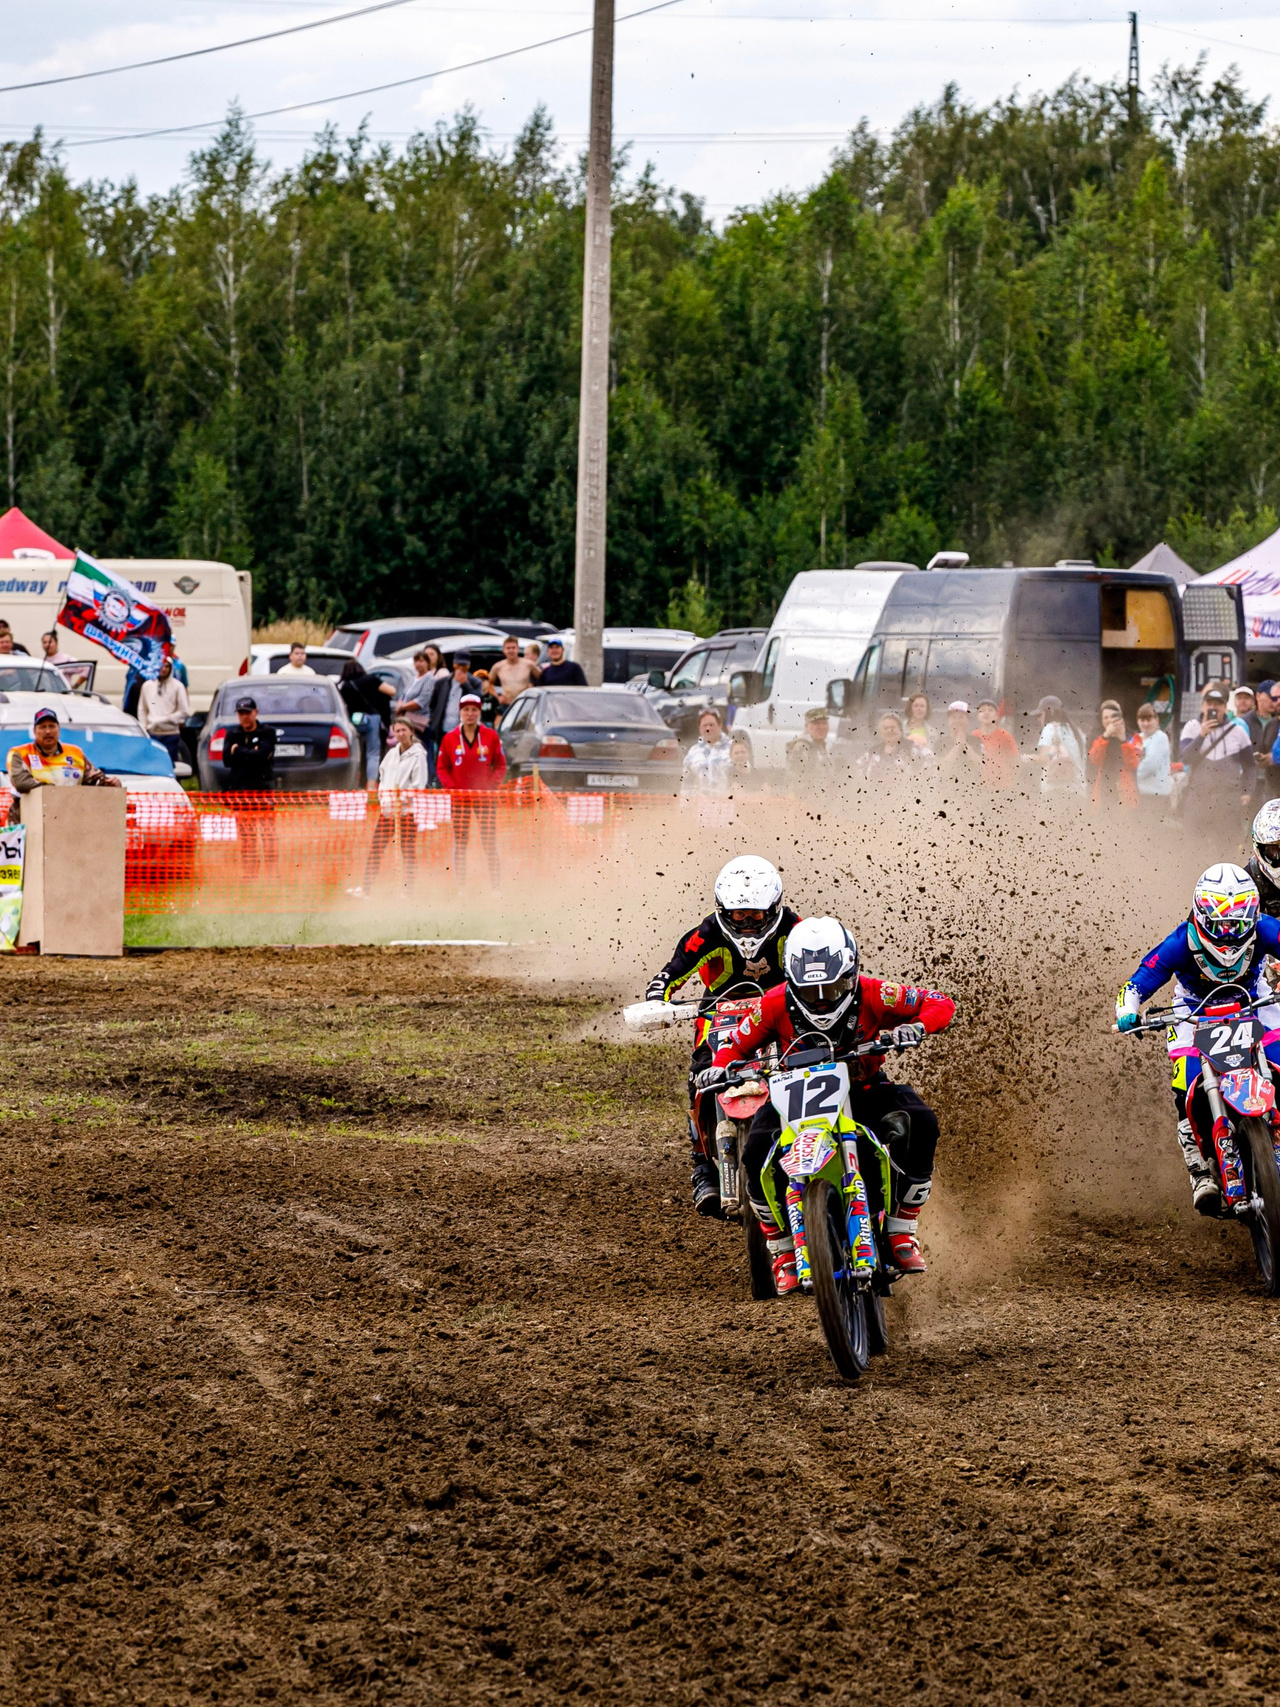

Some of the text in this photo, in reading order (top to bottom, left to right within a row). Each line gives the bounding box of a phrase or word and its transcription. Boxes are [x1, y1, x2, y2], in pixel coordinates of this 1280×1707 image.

[1209, 1021, 1254, 1056] 24
[784, 1074, 841, 1122] 12
[850, 1179, 874, 1258] Uktus Moto
